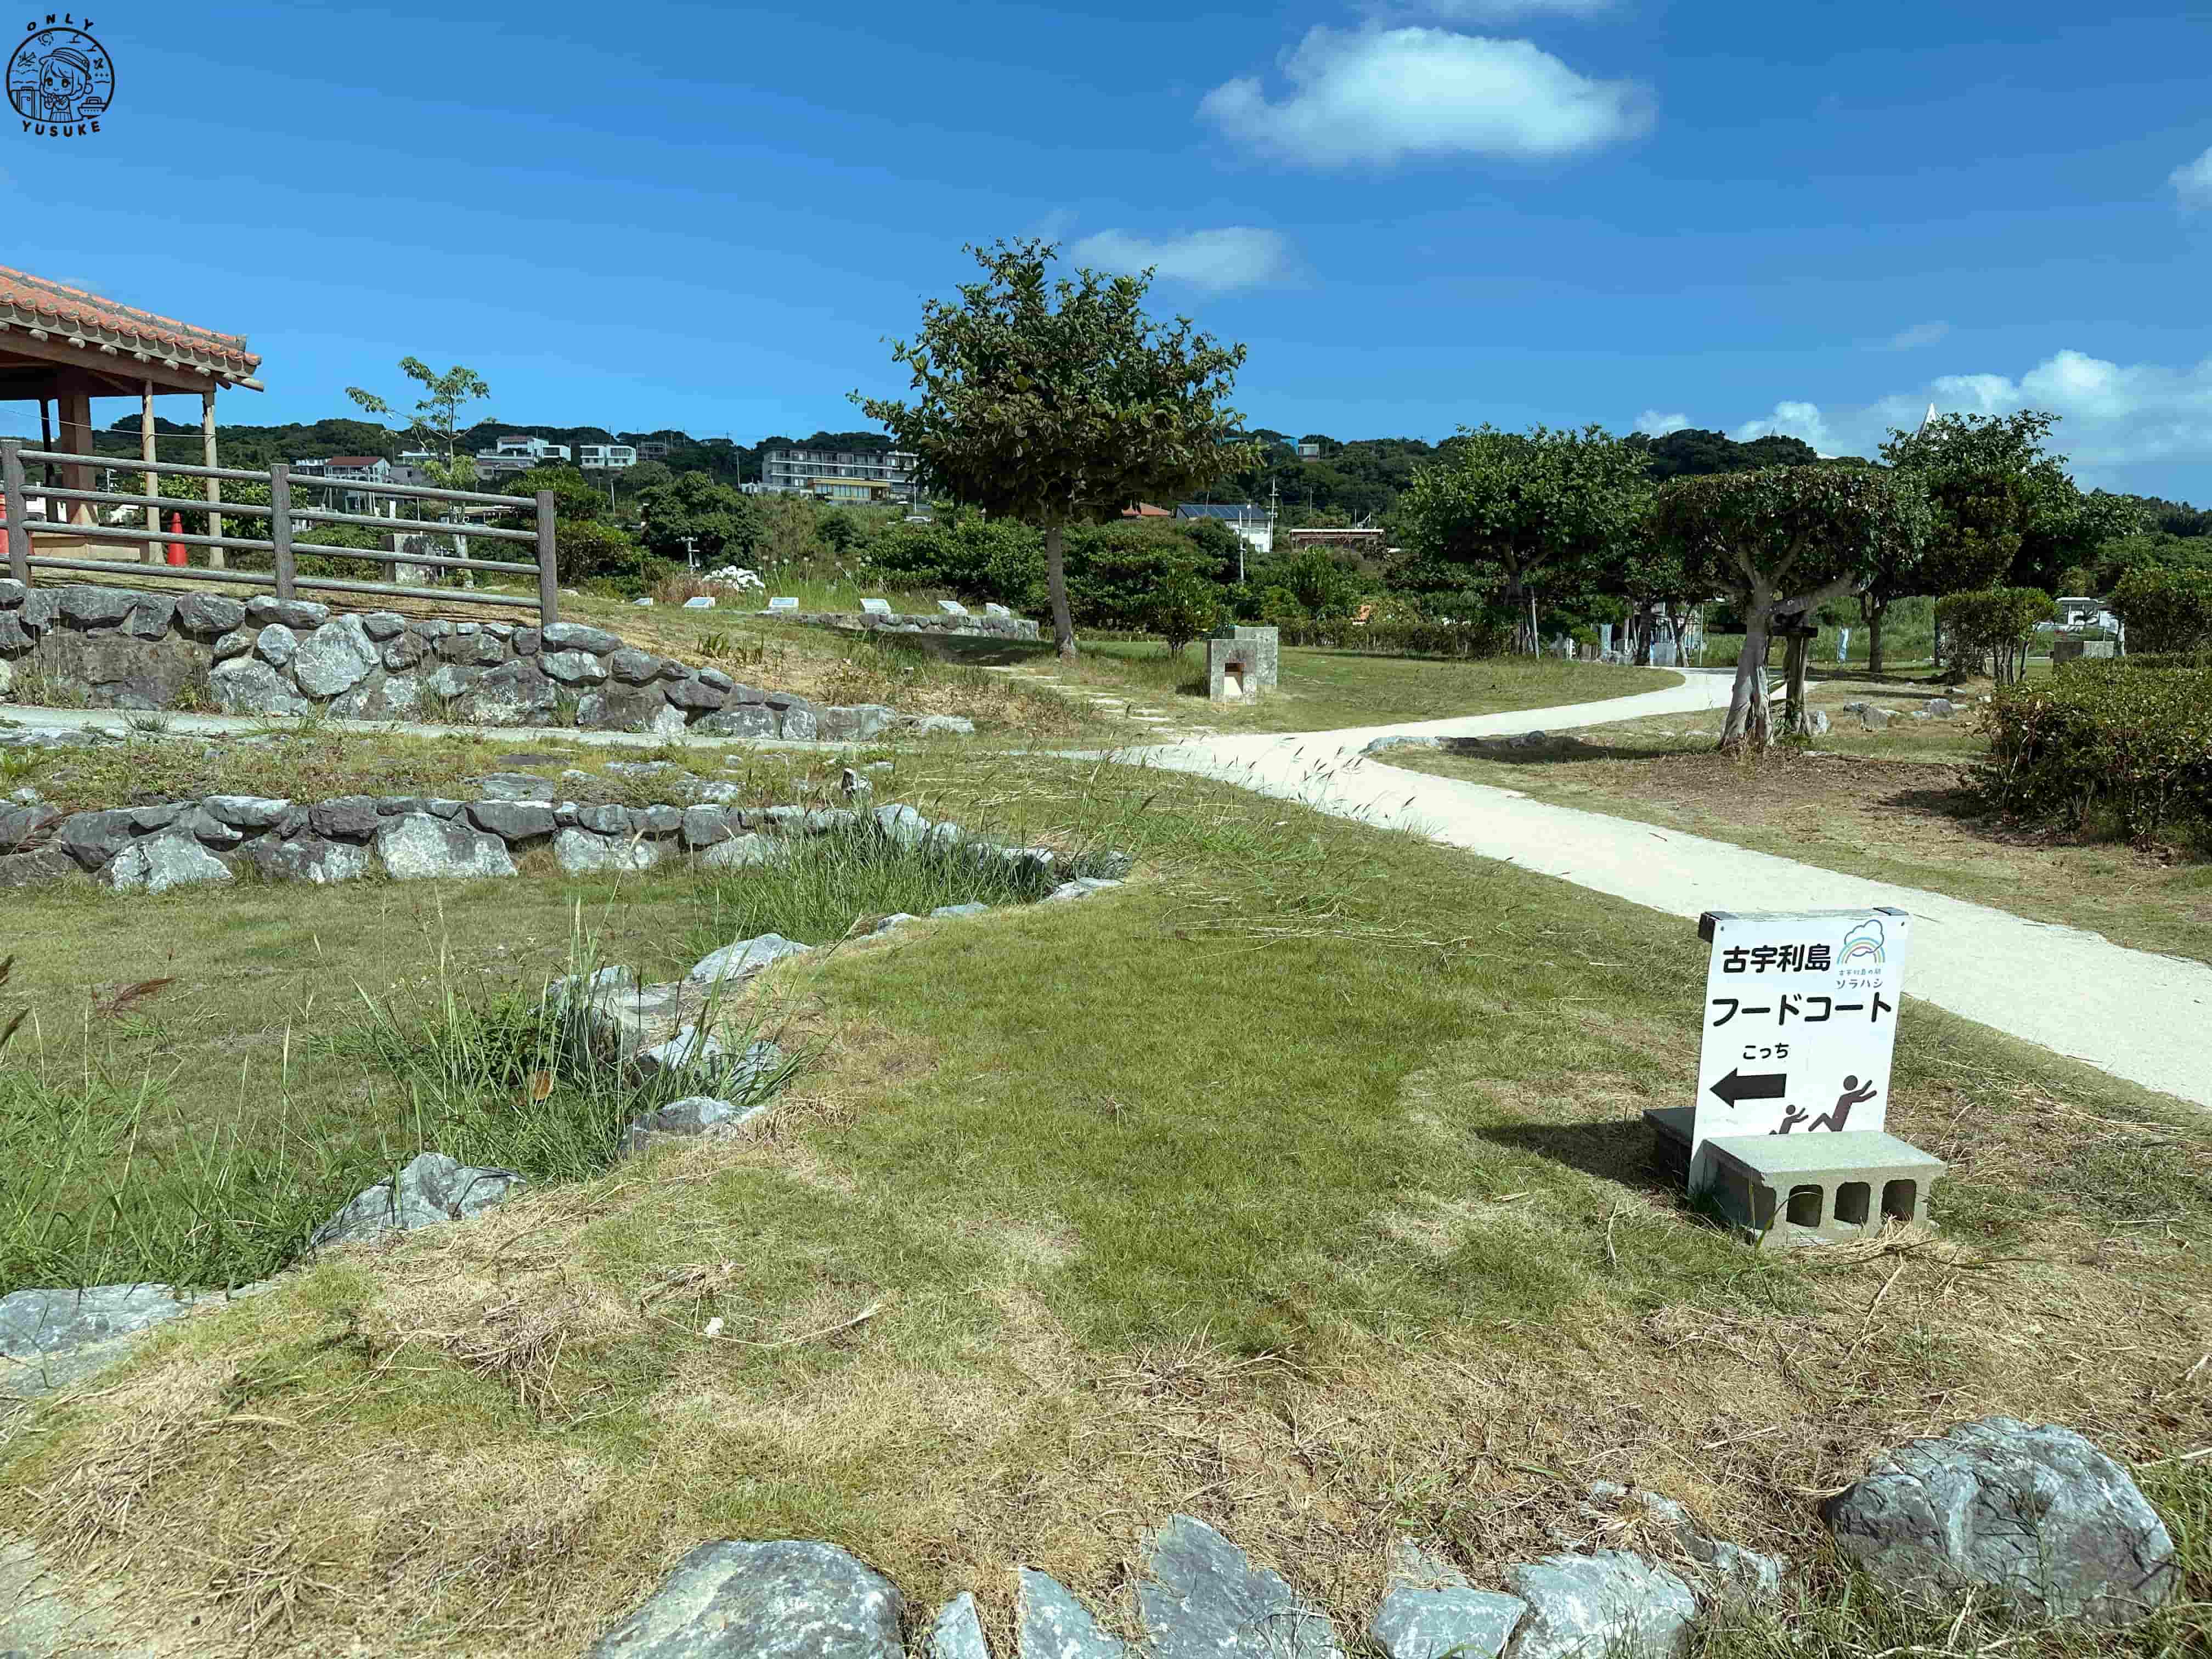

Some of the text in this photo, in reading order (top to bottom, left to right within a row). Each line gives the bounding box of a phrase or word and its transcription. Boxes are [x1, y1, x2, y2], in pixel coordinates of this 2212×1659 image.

[1723, 943, 1831, 973] 古宇利島
[1836, 978, 1883, 989] ソラハシ
[1712, 991, 1892, 1027] フードコート
[1743, 1042, 1790, 1060] こっち
